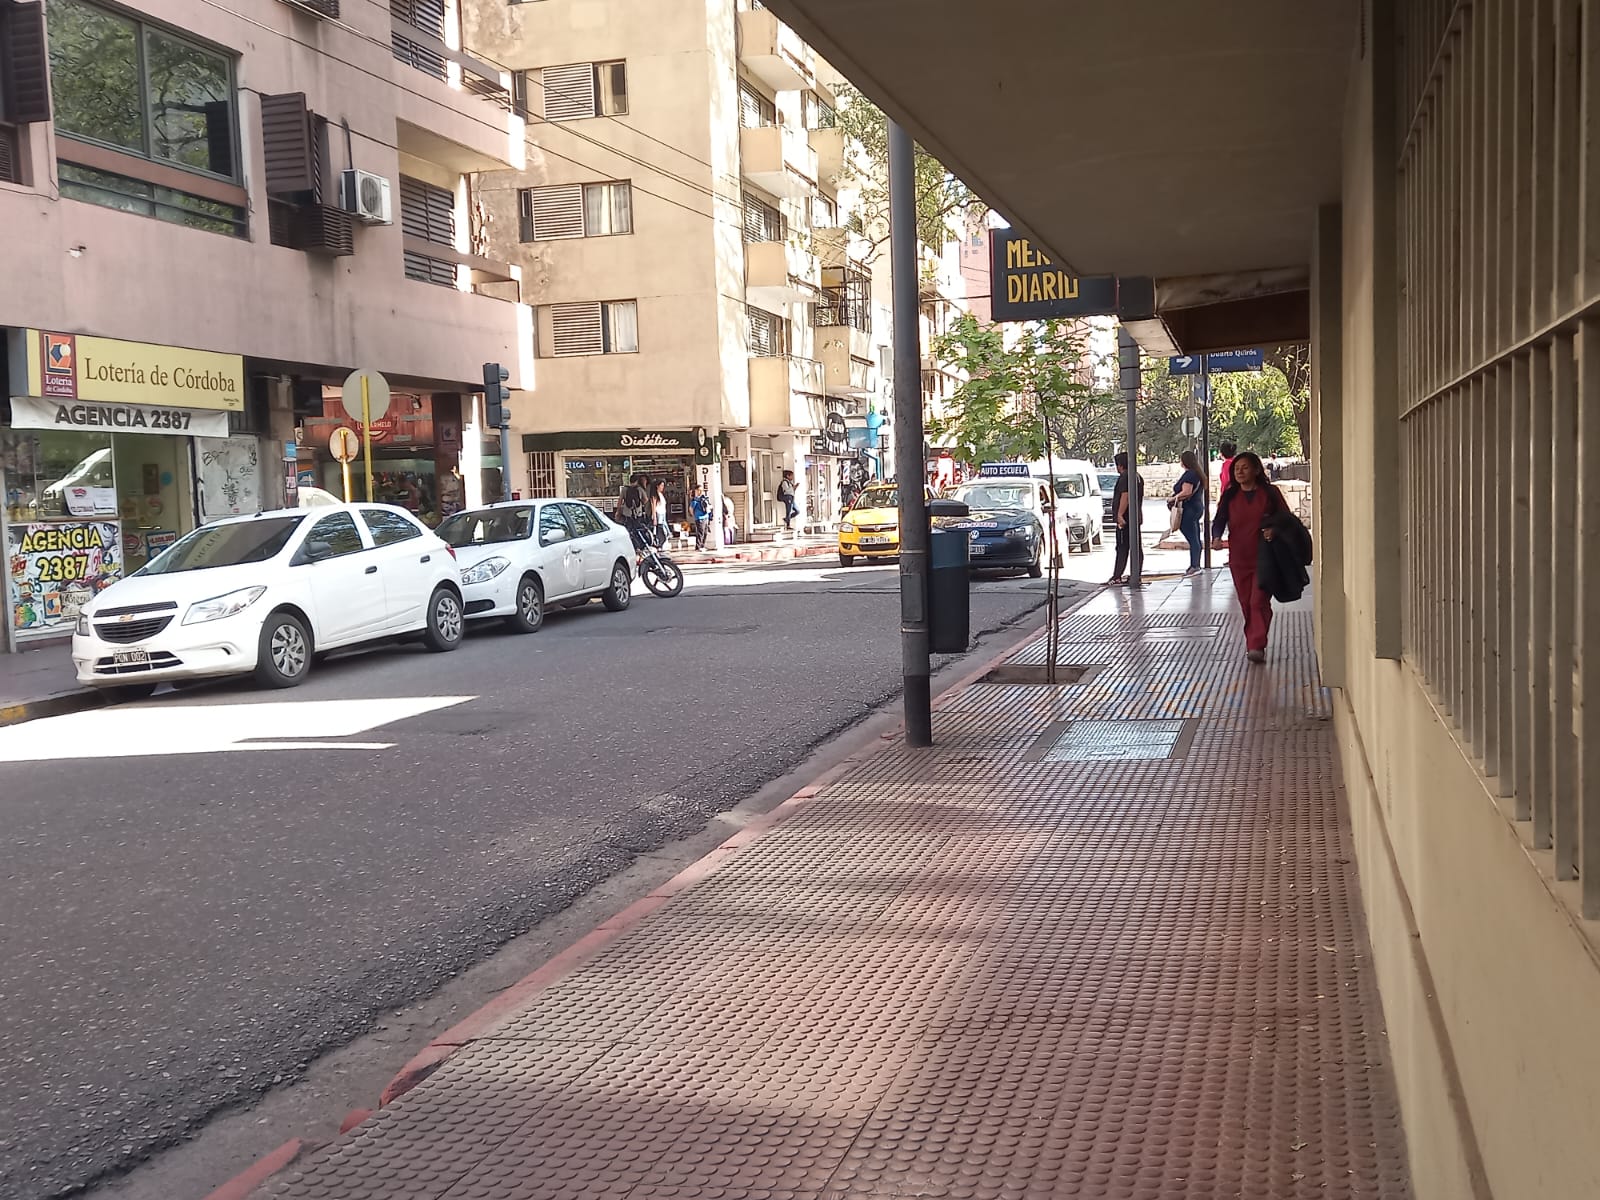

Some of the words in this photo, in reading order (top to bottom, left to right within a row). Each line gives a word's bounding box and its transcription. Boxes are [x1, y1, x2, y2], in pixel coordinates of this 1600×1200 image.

[1007, 270, 1078, 303] DIARIO
[84, 357, 145, 385] Lotería
[150, 365, 169, 386] de
[173, 367, 235, 393] Córdoba
[54, 404, 147, 428] AGENCIA
[150, 409, 192, 430] 2387
[620, 433, 680, 446] Dietética
[981, 466, 998, 475] AUTO
[999, 466, 1028, 475] ESCUELA
[19, 526, 104, 554] AGENCIA
[36, 554, 89, 582] 2387
